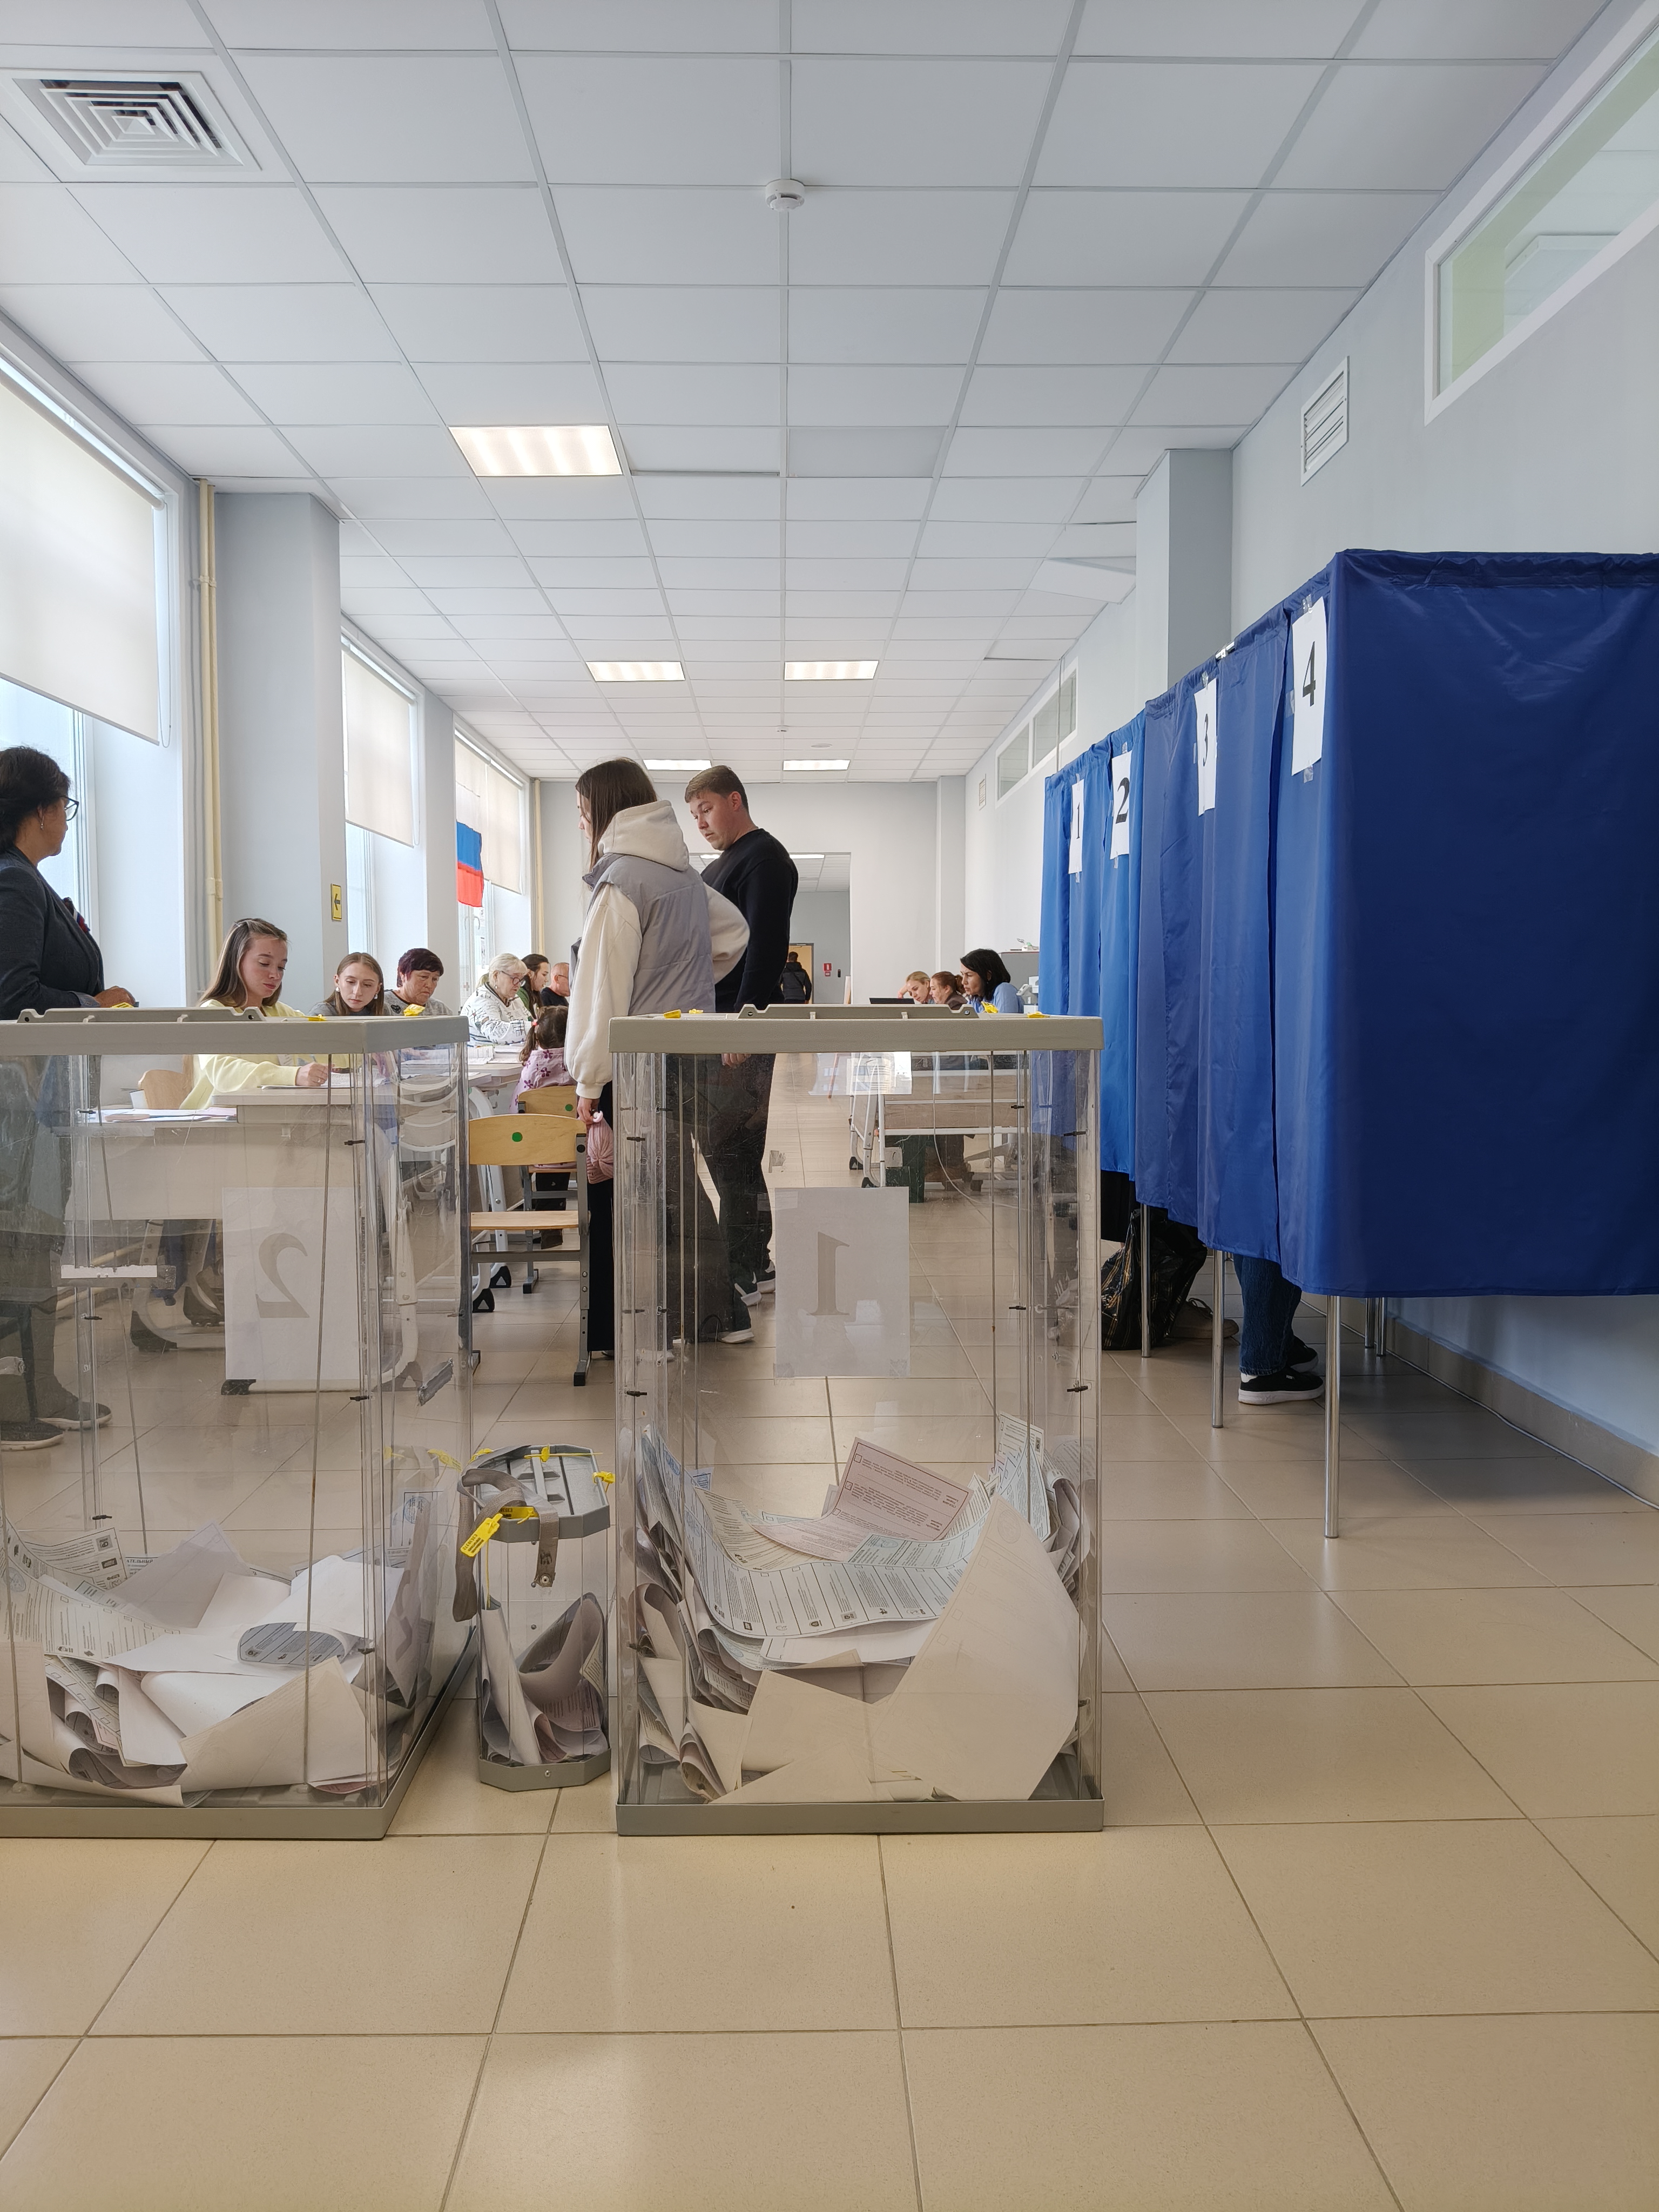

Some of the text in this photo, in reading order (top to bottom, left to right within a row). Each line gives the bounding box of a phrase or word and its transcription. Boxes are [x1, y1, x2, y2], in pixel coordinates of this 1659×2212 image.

[1303, 641, 1316, 706] 4
[1203, 713, 1209, 767] 3
[1076, 802, 1080, 839] 1
[1115, 777, 1130, 824] 2
